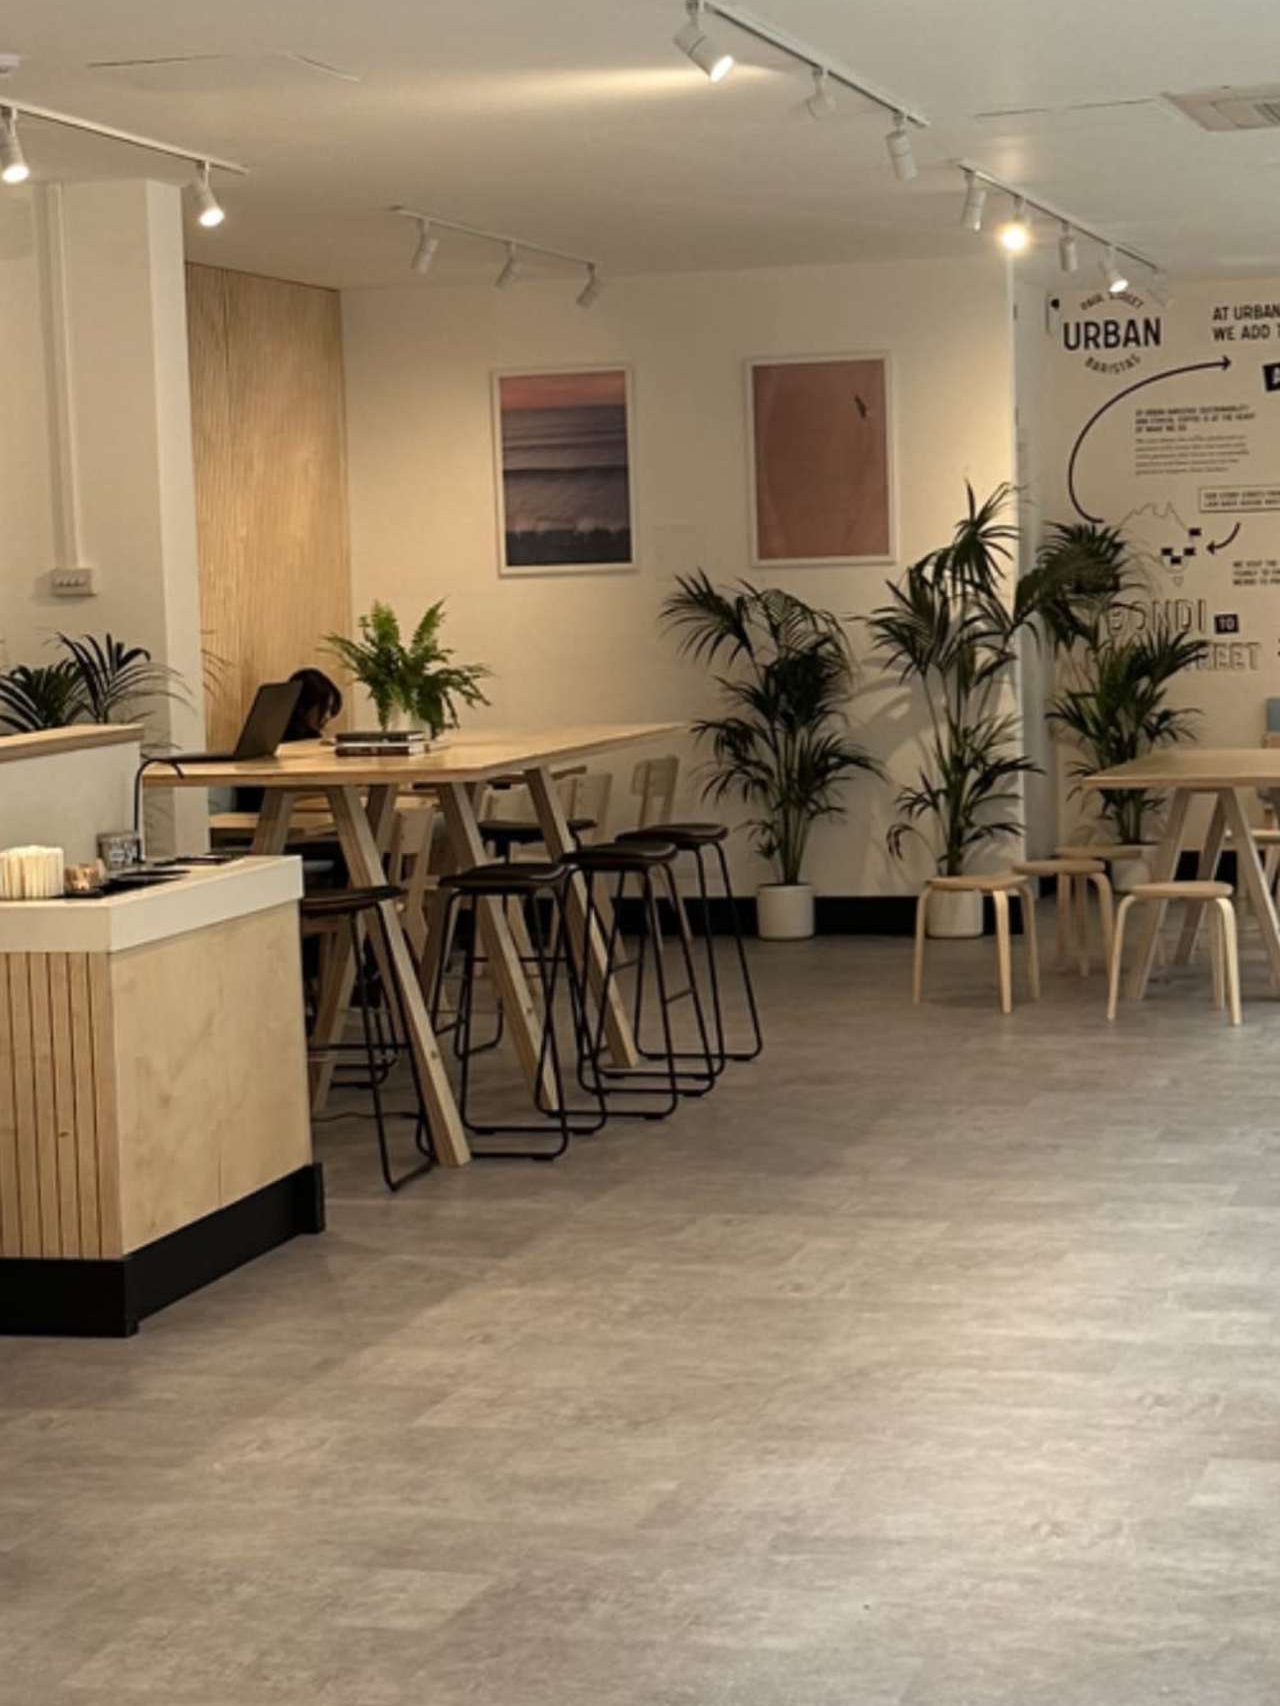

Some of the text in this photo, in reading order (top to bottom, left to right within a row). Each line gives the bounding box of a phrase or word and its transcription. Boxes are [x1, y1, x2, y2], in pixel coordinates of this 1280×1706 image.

[1213, 306, 1229, 321] AT
[1063, 316, 1161, 351] URBAN
[1213, 326, 1236, 342] WE
[1241, 323, 1271, 340] ADD
[1084, 353, 1142, 374] BARISTAS
[1219, 618, 1237, 632] TO
